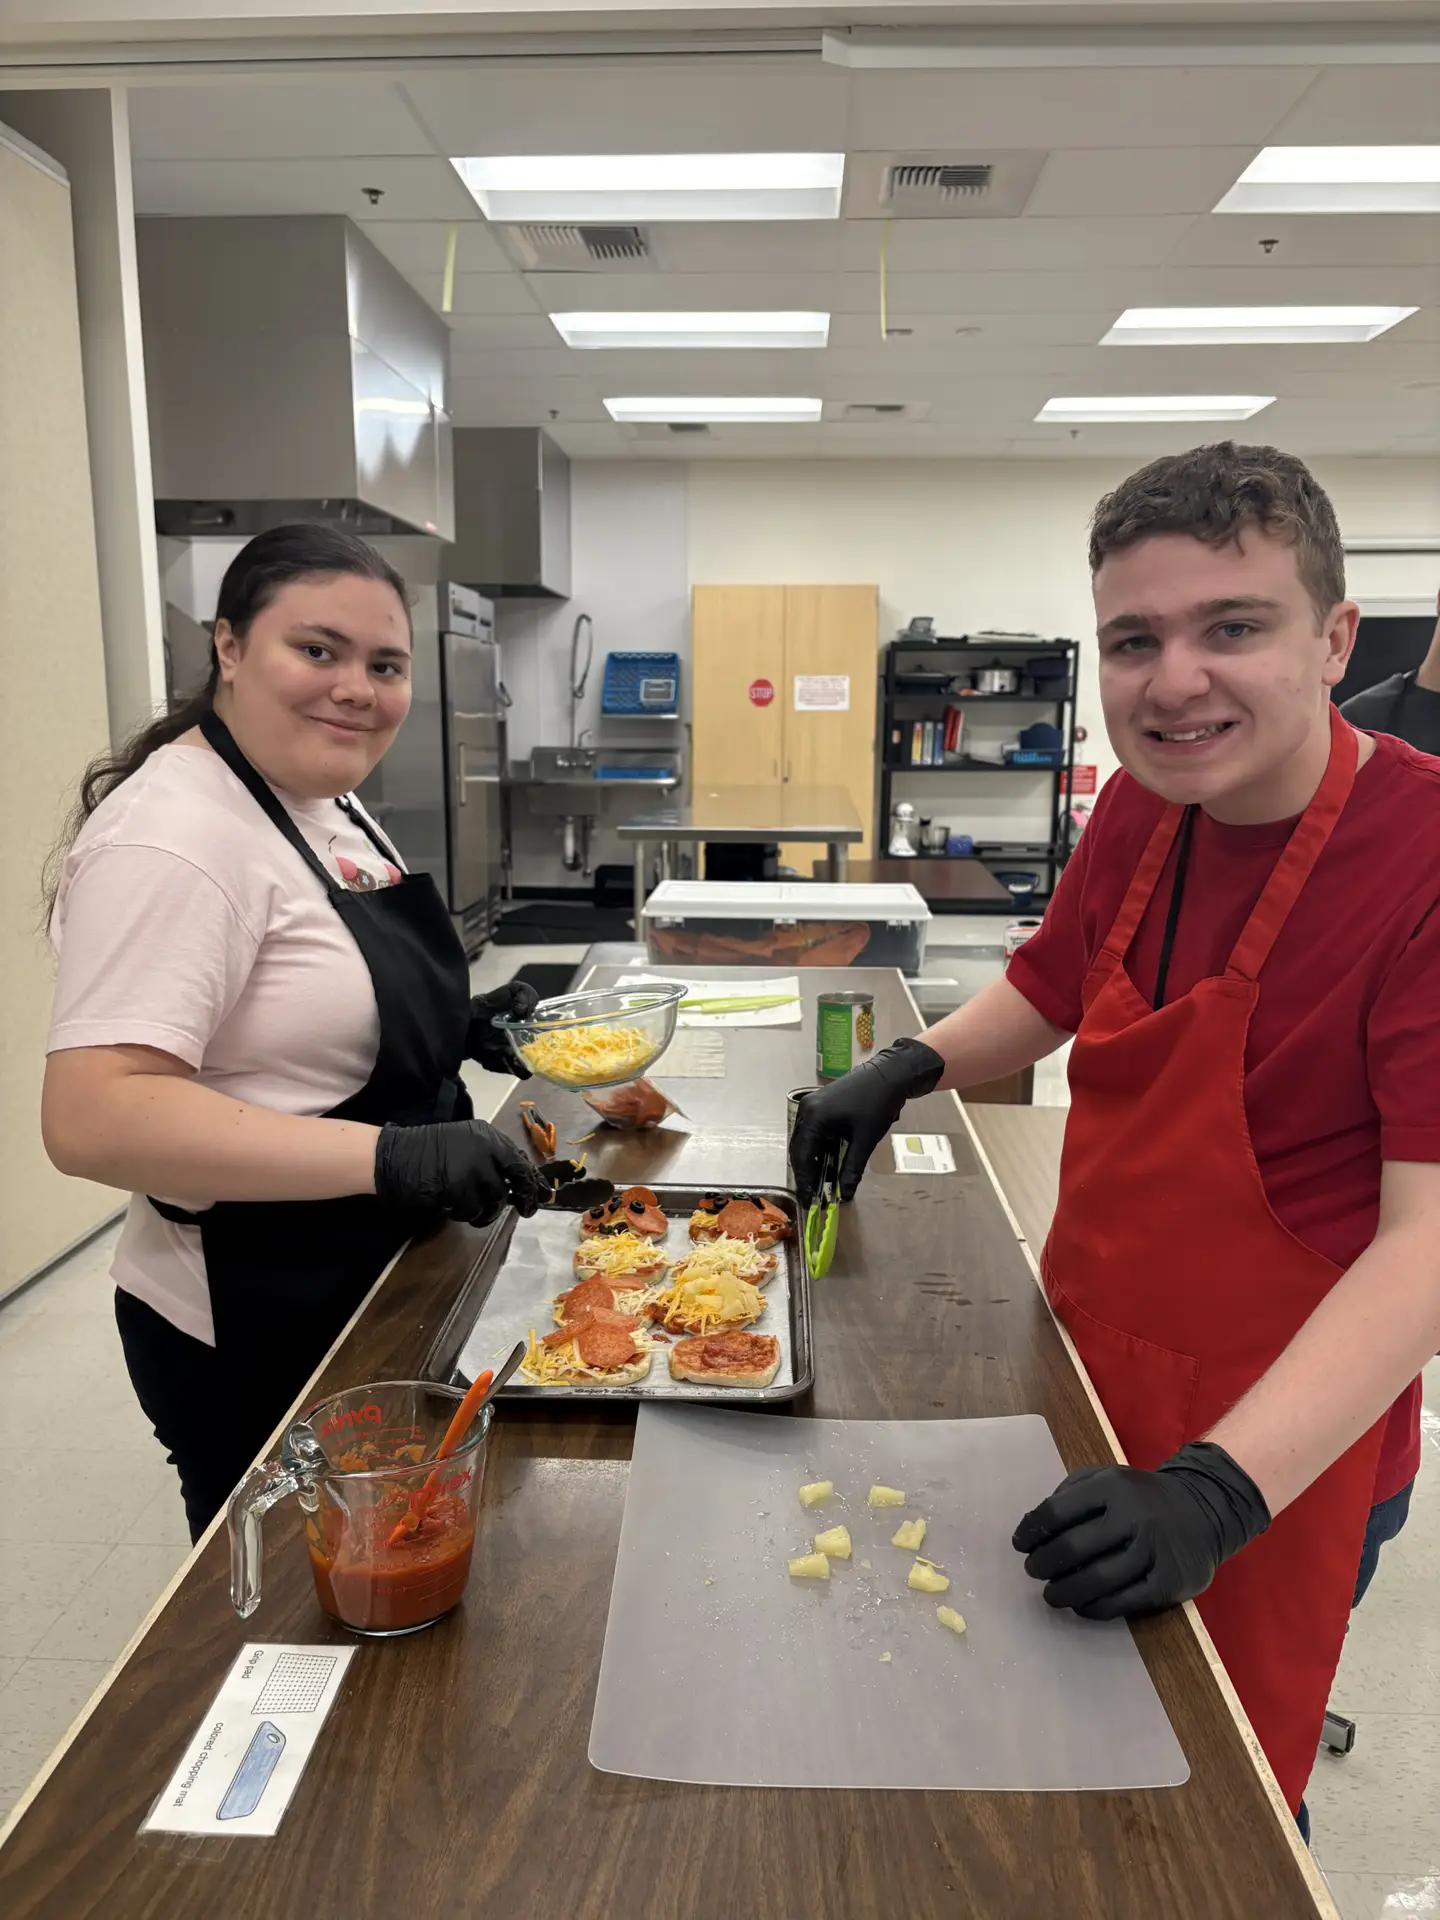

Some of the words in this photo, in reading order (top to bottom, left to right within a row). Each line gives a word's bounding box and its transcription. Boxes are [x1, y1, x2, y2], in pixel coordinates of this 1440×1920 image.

[750, 687, 773, 699] STOP
[248, 1650, 264, 1664] Grip
[241, 1665, 254, 1679] pad
[203, 1722, 223, 1750] colored
[181, 1752, 208, 1789] chopping
[173, 1790, 188, 1807] mat
